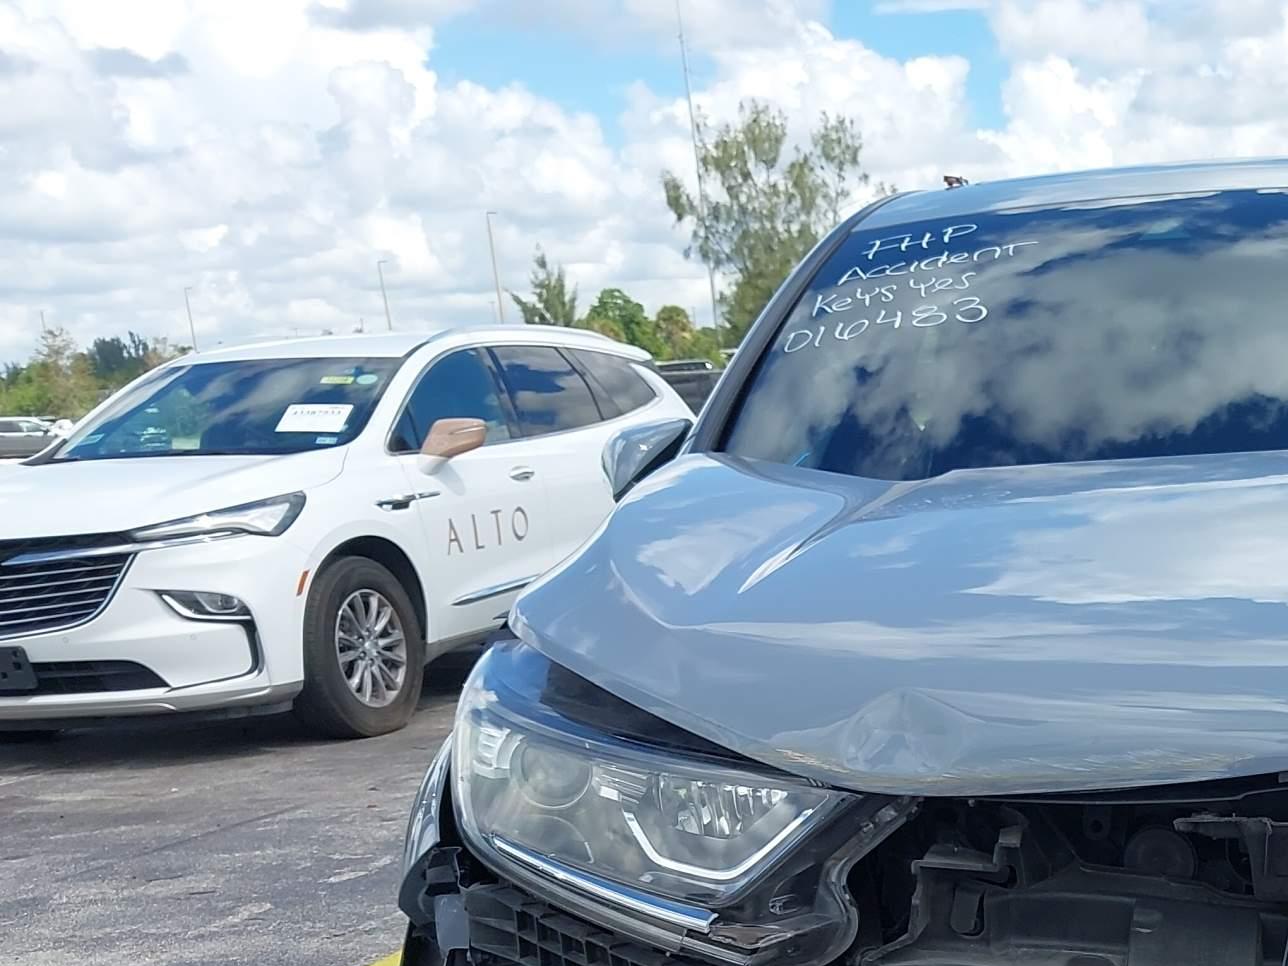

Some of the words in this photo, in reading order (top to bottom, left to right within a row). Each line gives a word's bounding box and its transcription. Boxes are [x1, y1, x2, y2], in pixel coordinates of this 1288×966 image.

[860, 223, 979, 260] FHP
[783, 296, 989, 353] 016483
[447, 506, 529, 556] ALTO
